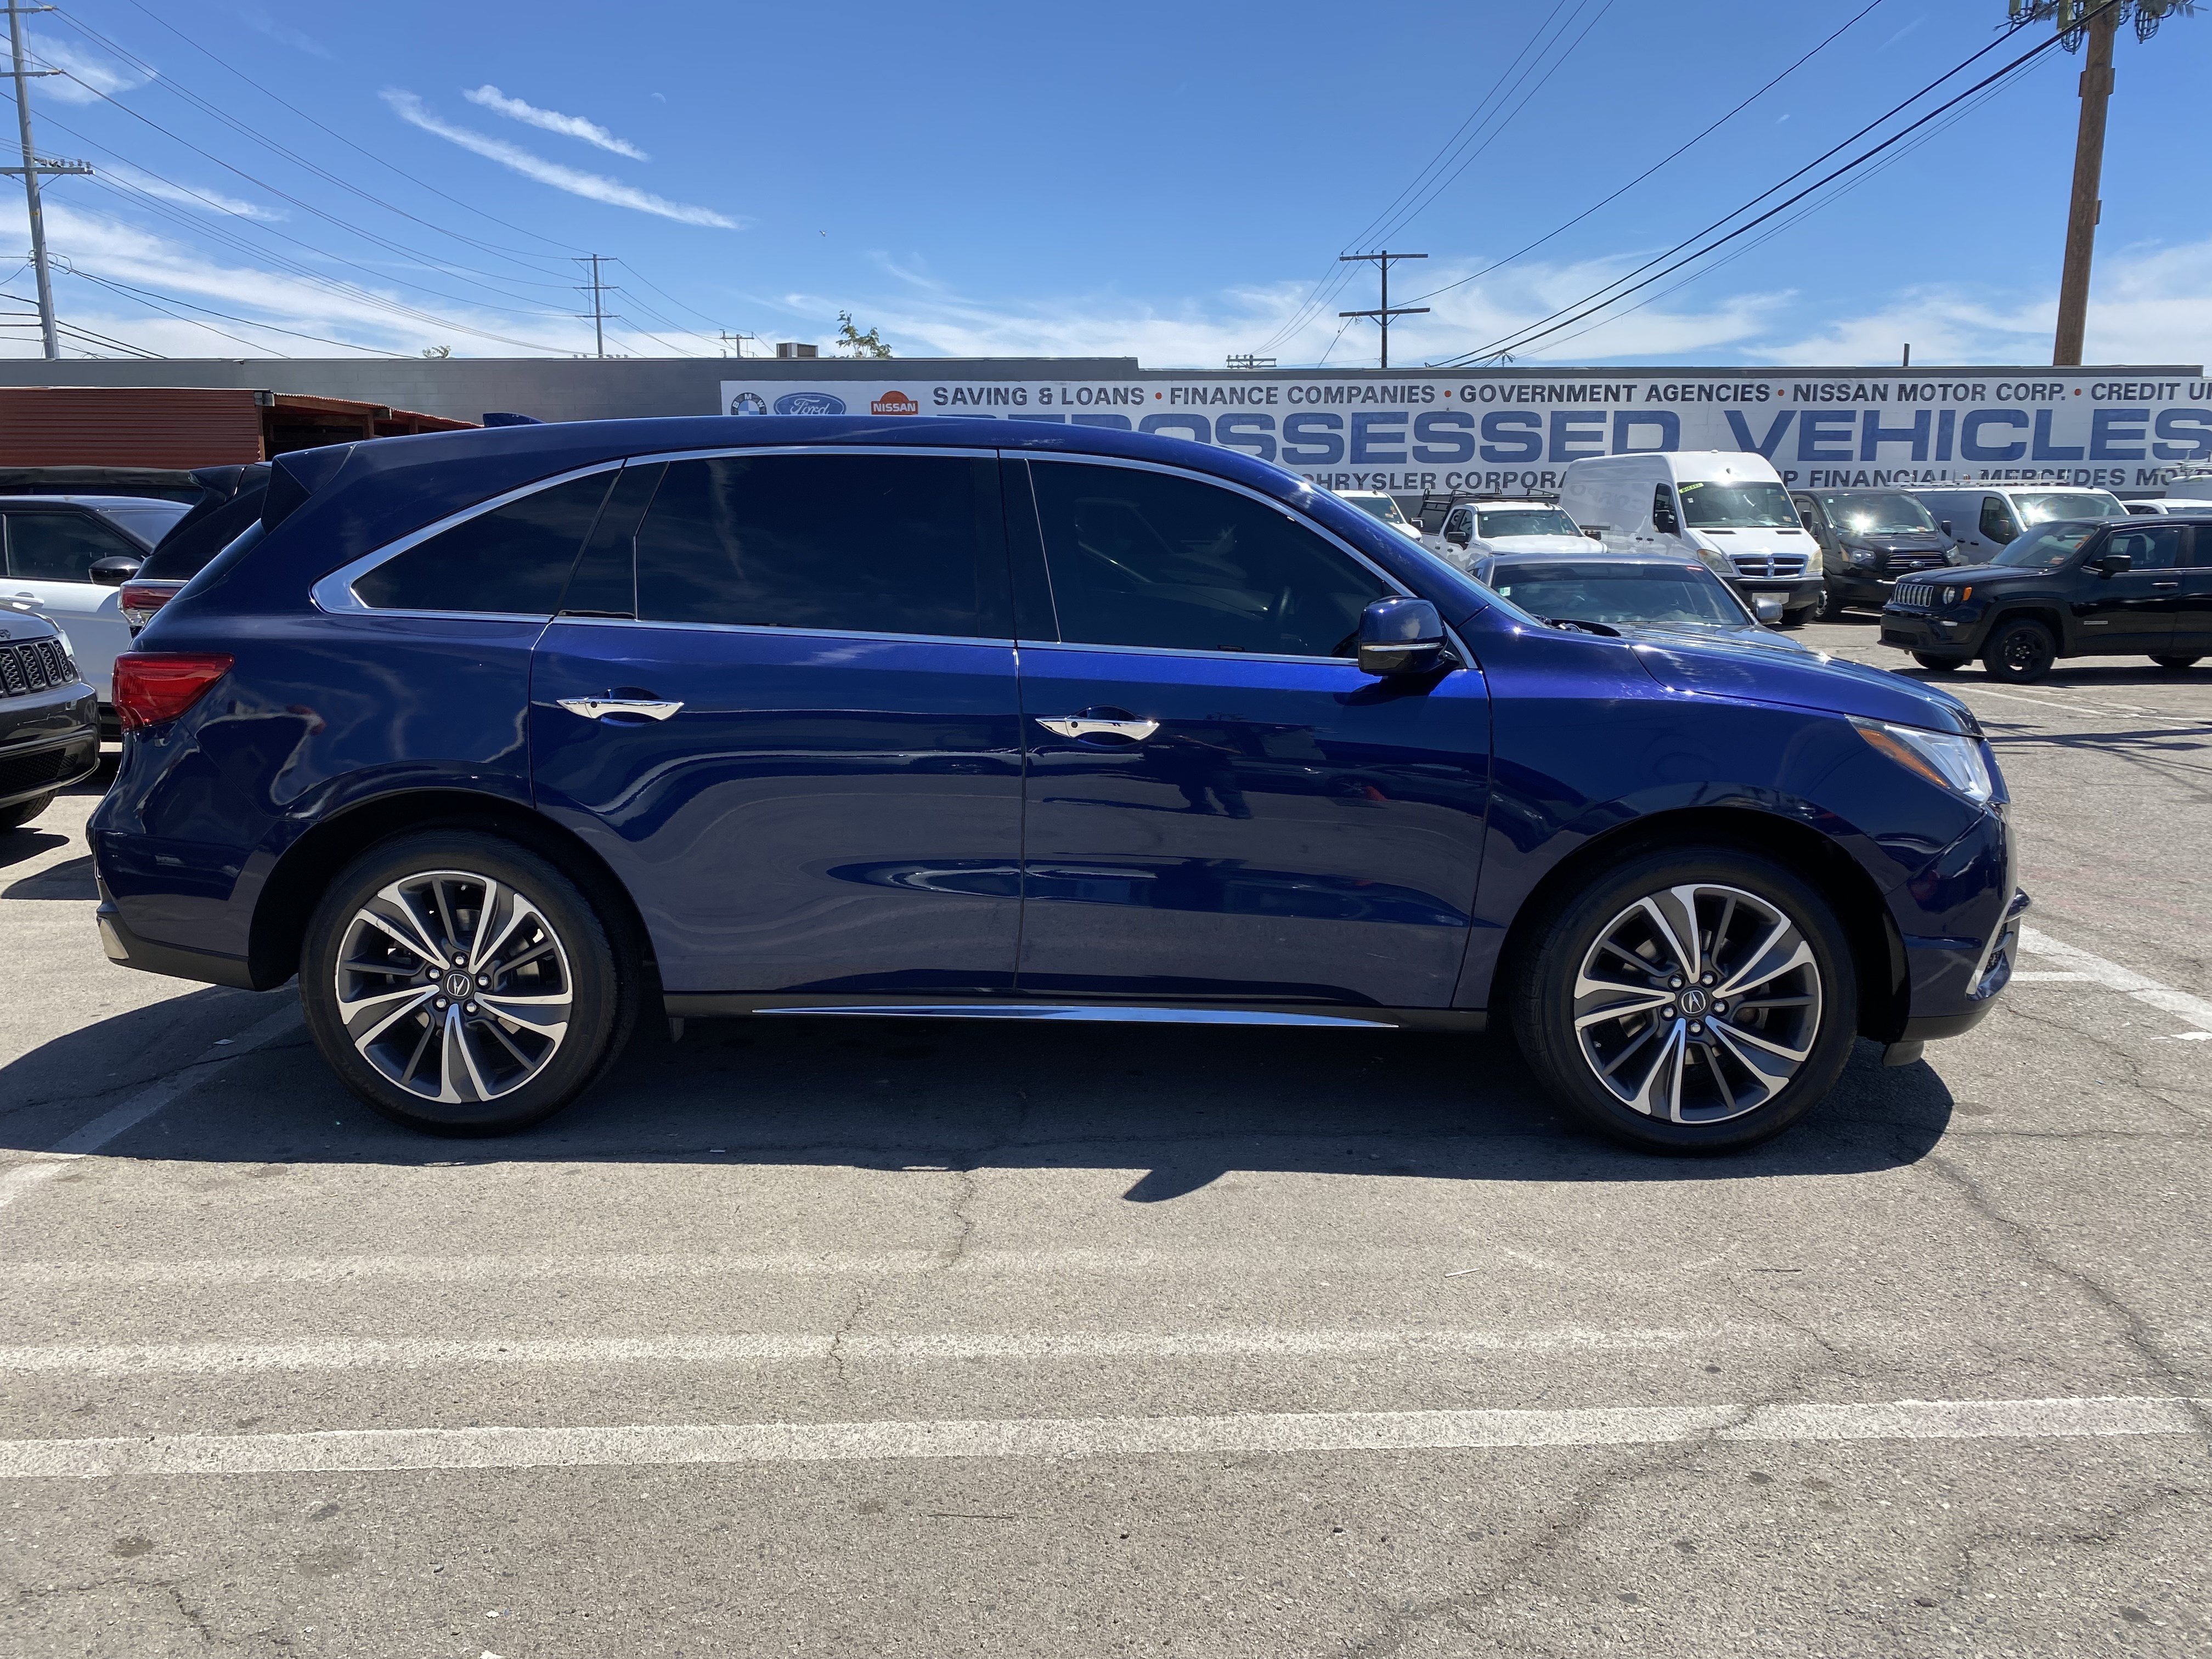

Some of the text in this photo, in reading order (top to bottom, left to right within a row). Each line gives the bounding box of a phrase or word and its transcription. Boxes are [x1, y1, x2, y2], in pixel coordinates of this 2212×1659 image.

[933, 387, 1144, 405] SAVING & LOANS
[1170, 385, 1435, 405] FINANCE COMPANIES
[1460, 384, 1770, 403] GOVERNMENT AGENCIES
[1793, 383, 2066, 402] NISSAN MOTOR CORP.
[2091, 383, 2181, 400] CREDIT
[732, 393, 765, 409] BMW
[790, 398, 830, 415] Ford
[873, 402, 916, 413] NISSAN
[936, 409, 2212, 464] OSSESSED VEHICLES
[1980, 469, 2126, 486] MERCEDES
